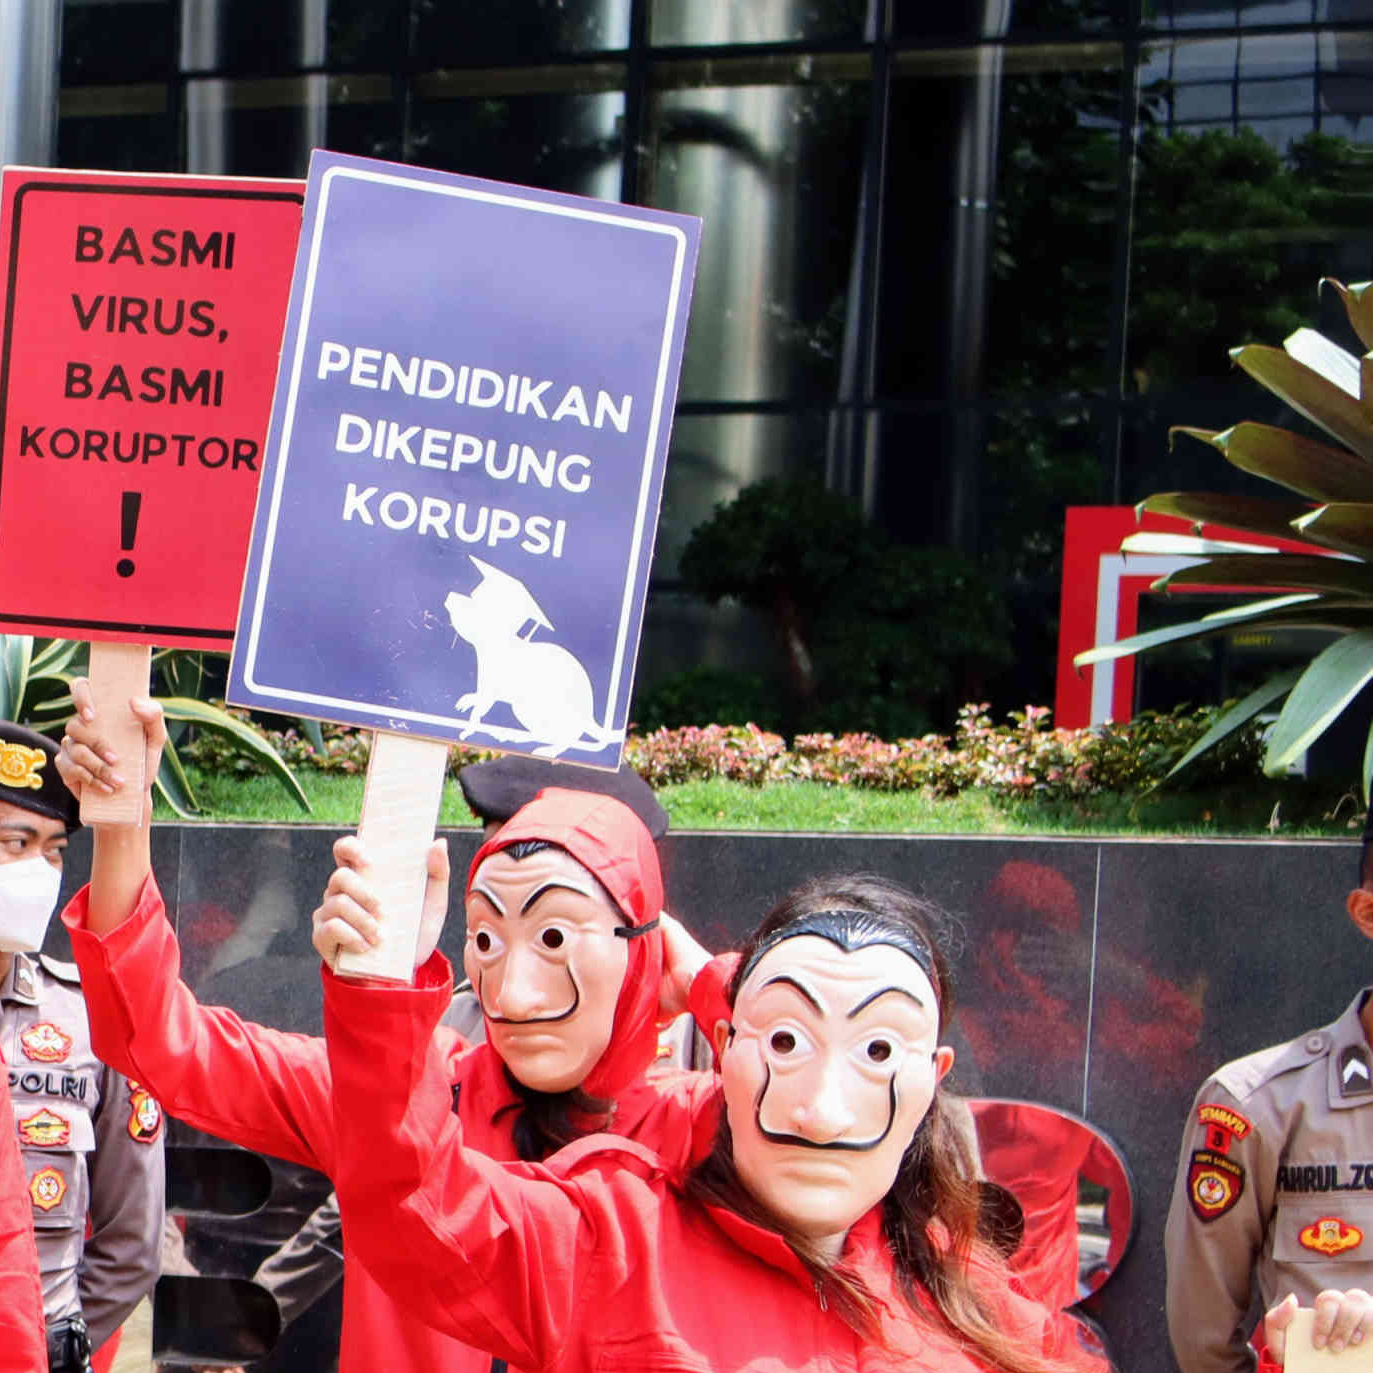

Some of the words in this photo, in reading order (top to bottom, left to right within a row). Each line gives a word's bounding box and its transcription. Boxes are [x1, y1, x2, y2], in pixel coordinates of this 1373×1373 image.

[75, 225, 236, 270] BASMI
[71, 294, 229, 344] VIRUS,
[64, 362, 224, 407] BASMI
[317, 341, 633, 433] PENDIDIKAN
[20, 425, 259, 472] KORUPTOR
[335, 413, 591, 493] DIKEPUNG
[116, 491, 142, 579] !
[342, 482, 566, 558] KORUPSI
